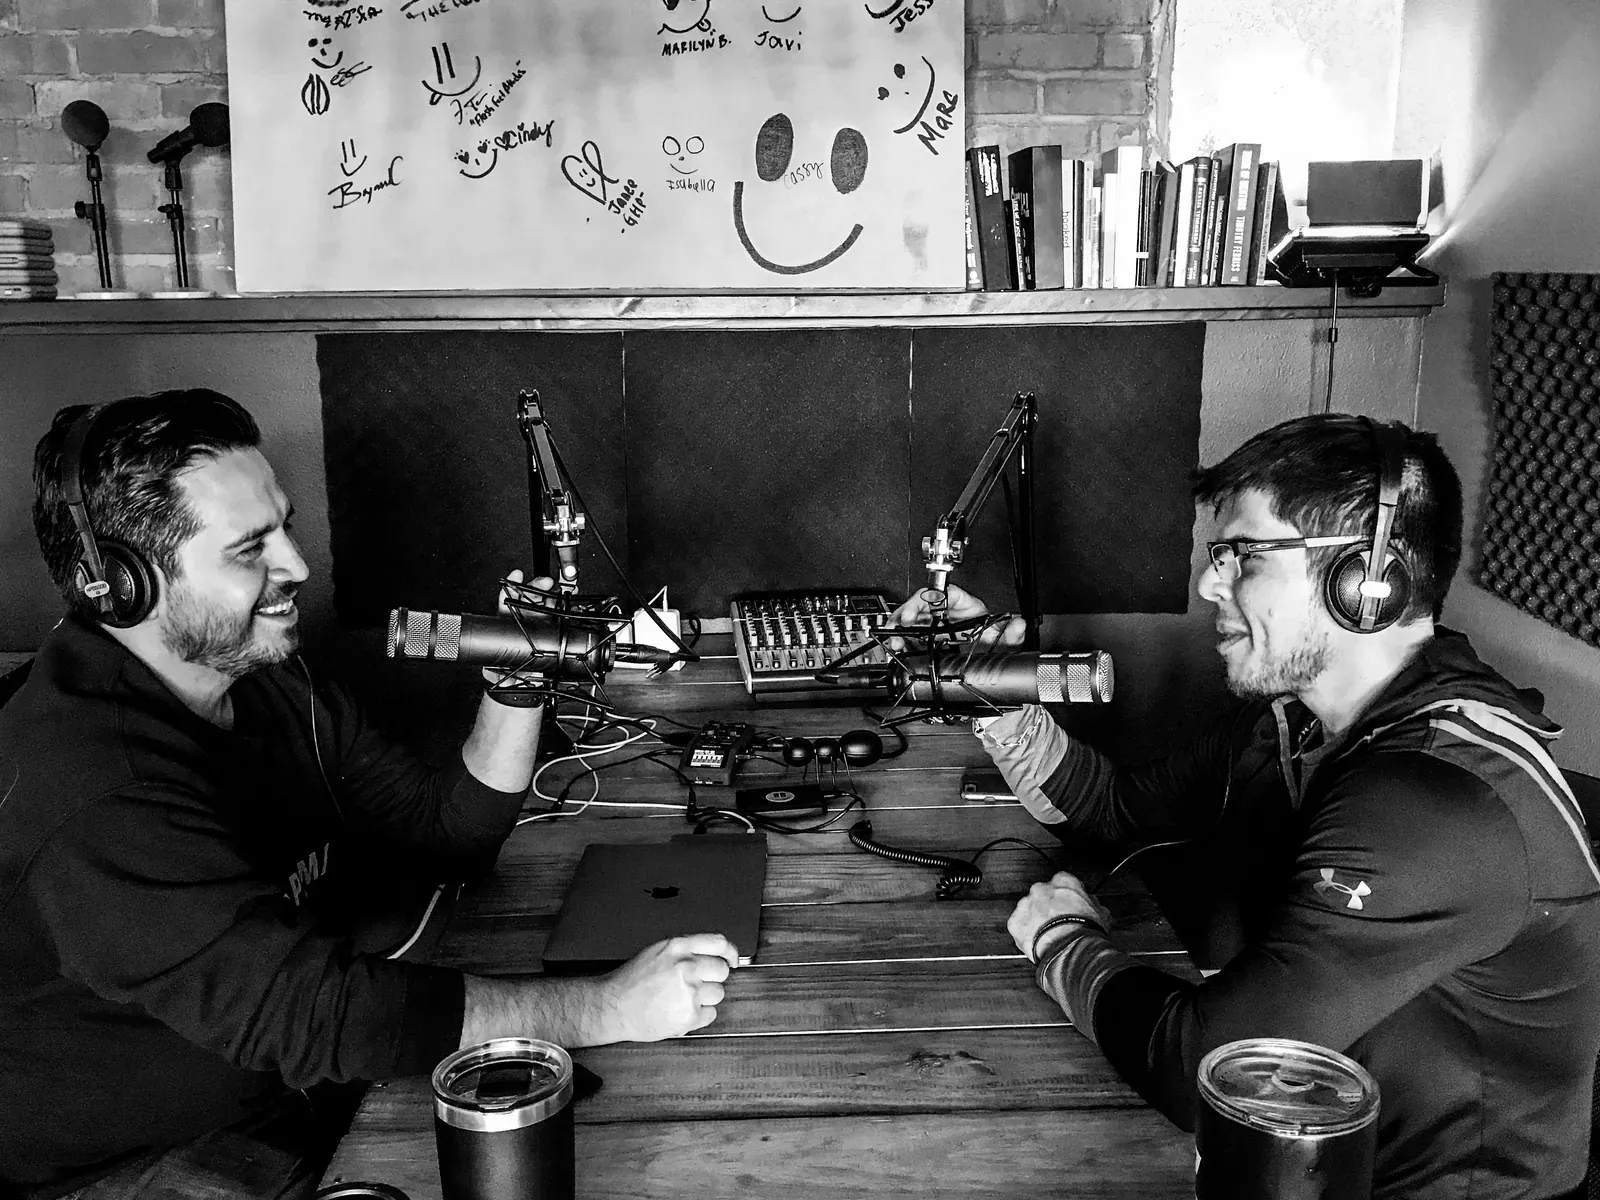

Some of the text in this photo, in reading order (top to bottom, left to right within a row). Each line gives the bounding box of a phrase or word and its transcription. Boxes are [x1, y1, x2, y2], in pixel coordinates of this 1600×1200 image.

[661, 37, 715, 56] MARILYN
[754, 30, 802, 51] Javi
[503, 120, 555, 149] Cindy
[1062, 211, 1071, 248] hooked
[1233, 215, 1246, 245] TIMOTHY
[1230, 245, 1243, 272] FERRISS
